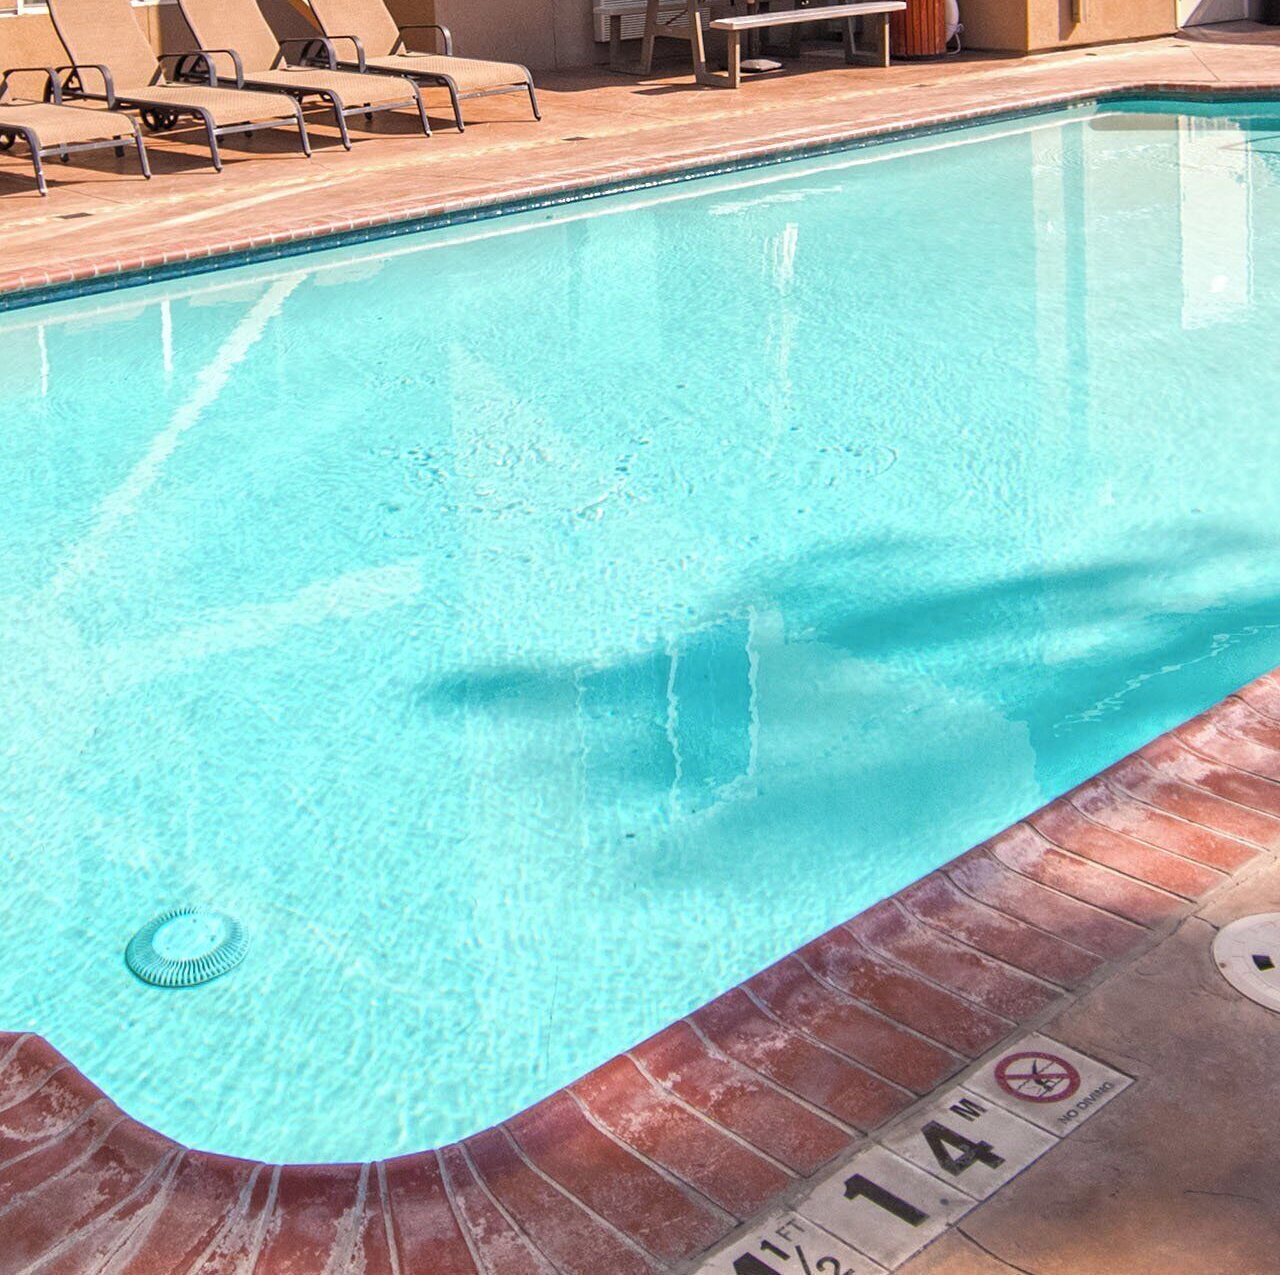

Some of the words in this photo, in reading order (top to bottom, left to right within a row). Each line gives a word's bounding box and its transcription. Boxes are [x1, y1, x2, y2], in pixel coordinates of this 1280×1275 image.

[1057, 1108, 1080, 1125] NO
[1076, 1081, 1115, 1110] DIVING
[775, 1218, 806, 1243] FT
[948, 1098, 989, 1122] M
